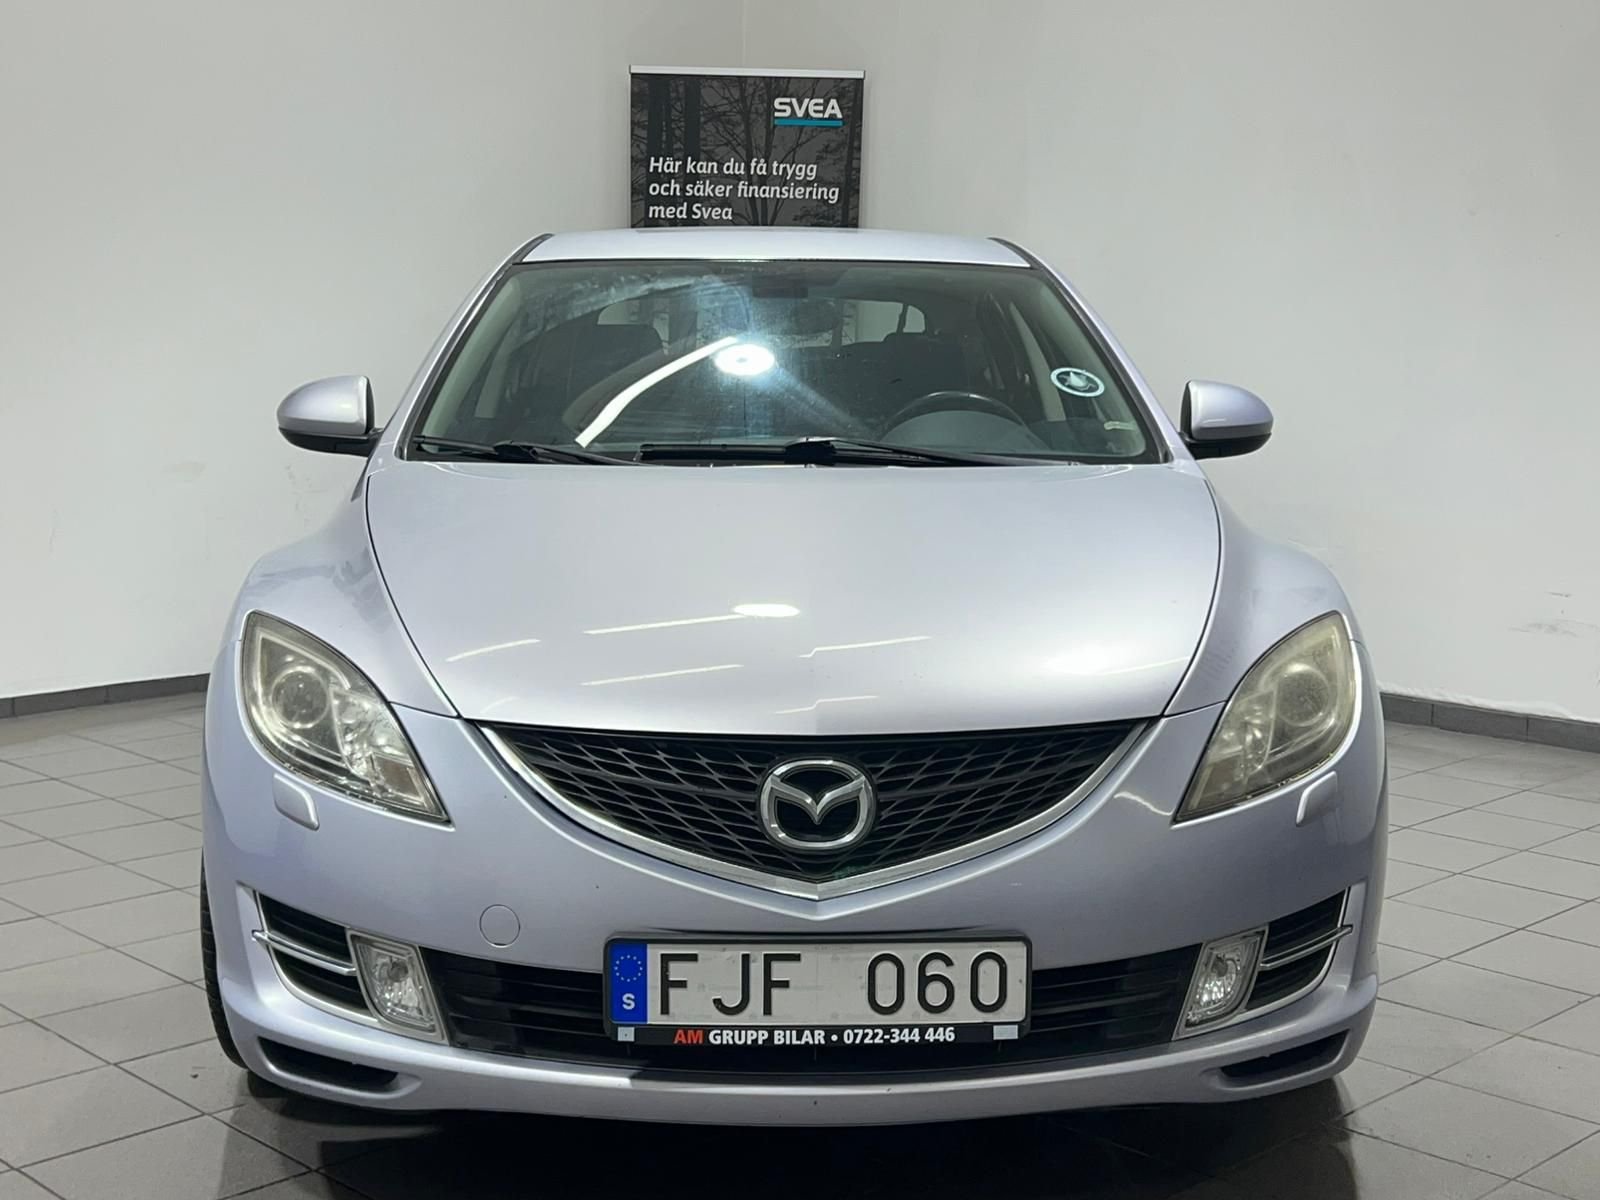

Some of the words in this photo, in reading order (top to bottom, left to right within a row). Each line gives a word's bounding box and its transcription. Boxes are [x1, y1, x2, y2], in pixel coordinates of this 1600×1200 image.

[773, 97, 843, 119] SVEA
[649, 156, 682, 174] Här
[686, 156, 719, 175] kan
[723, 158, 745, 175] du
[750, 158, 767, 176] få
[772, 160, 818, 180] trygg
[649, 180, 681, 196] och
[685, 180, 733, 197] säker
[737, 181, 840, 204] finansiering
[648, 203, 687, 219] med
[691, 203, 733, 220] Svea
[659, 952, 802, 1016] FJF
[866, 951, 1008, 1016] 060
[621, 993, 636, 1011] S
[673, 1028, 704, 1045] AM
[708, 1028, 769, 1045] GRUPP
[773, 1028, 825, 1045] BILAR
[843, 1027, 921, 1044] 0722-344
[924, 1026, 956, 1043] 446
